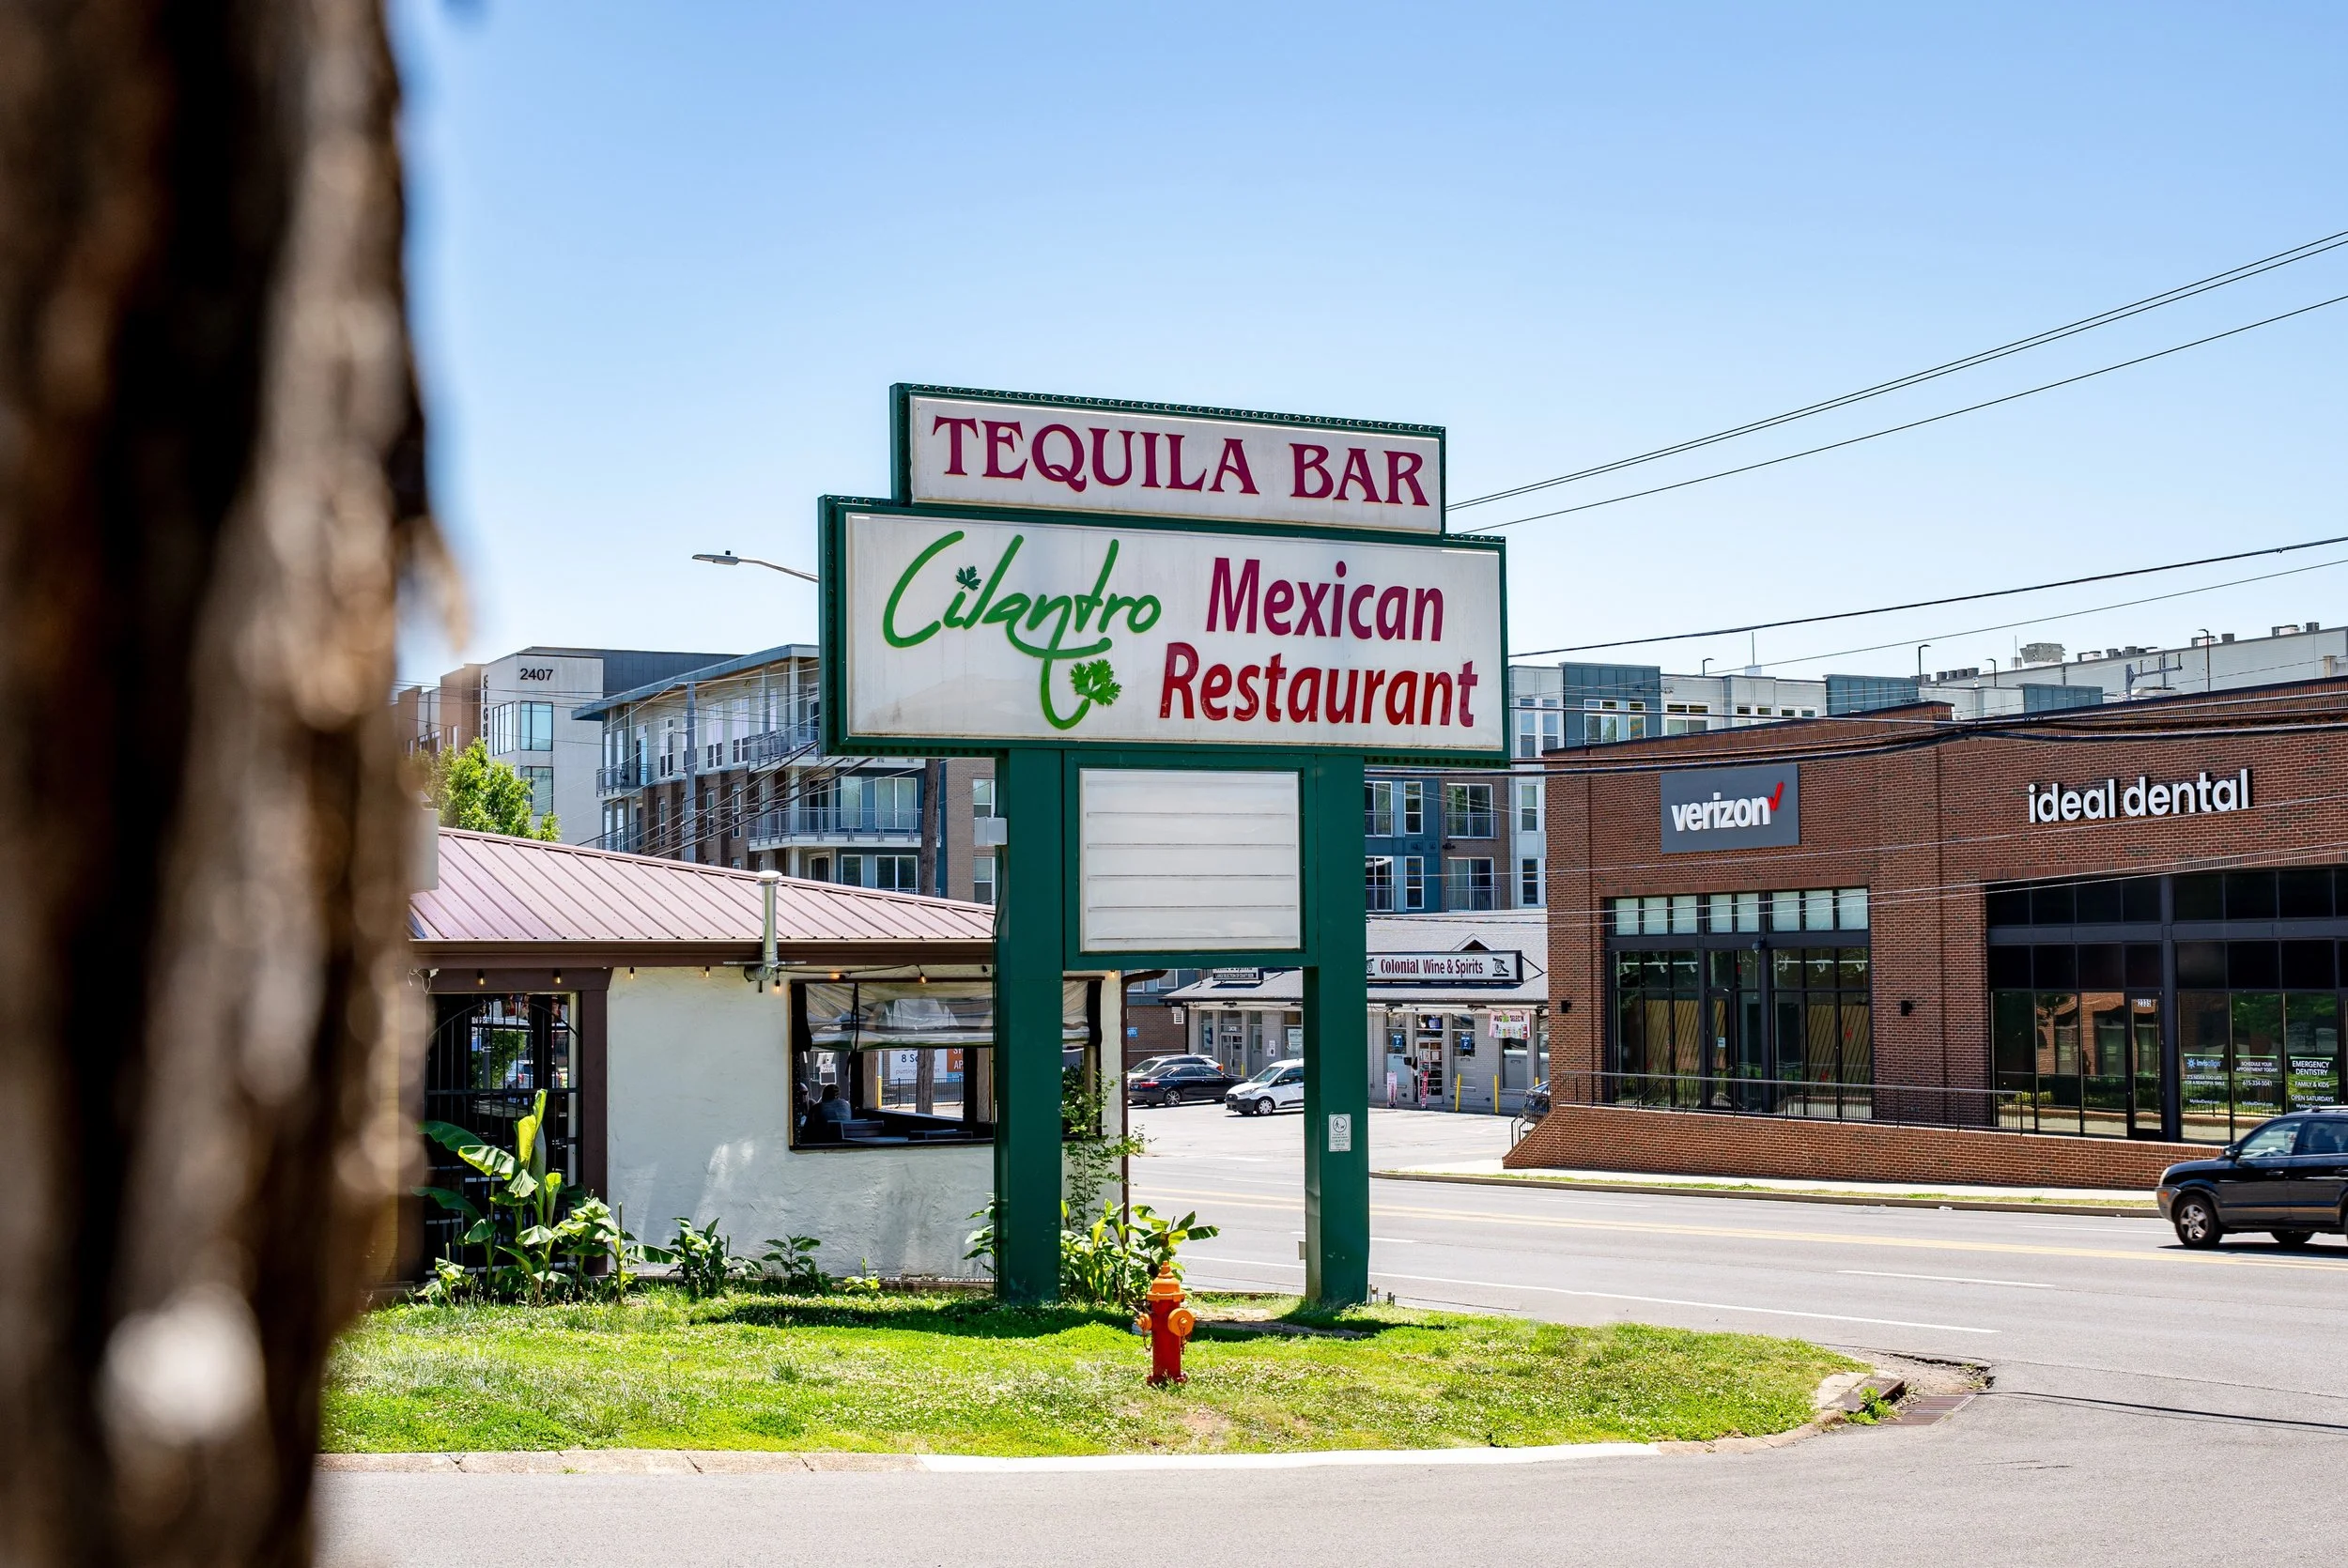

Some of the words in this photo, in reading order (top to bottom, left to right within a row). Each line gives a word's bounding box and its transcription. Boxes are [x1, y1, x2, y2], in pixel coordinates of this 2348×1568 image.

[933, 414, 1259, 496] TEQUILA
[1289, 442, 1430, 507] BAR
[1207, 558, 1444, 643] Mexican
[883, 530, 1162, 730] Cilantro
[519, 668, 554, 682] 2407
[1159, 642, 1478, 729] Restaurant
[1671, 792, 1771, 833] verizon
[2029, 778, 2116, 823] ideal
[2123, 768, 2249, 817] dental
[1381, 959, 1419, 975] Colonial
[1423, 959, 1444, 975] Wine
[1447, 959, 1454, 975] &
[1455, 959, 1483, 978] Spirits
[902, 1054, 906, 1063] 8
[2292, 1060, 2330, 1068] EMERGENCY
